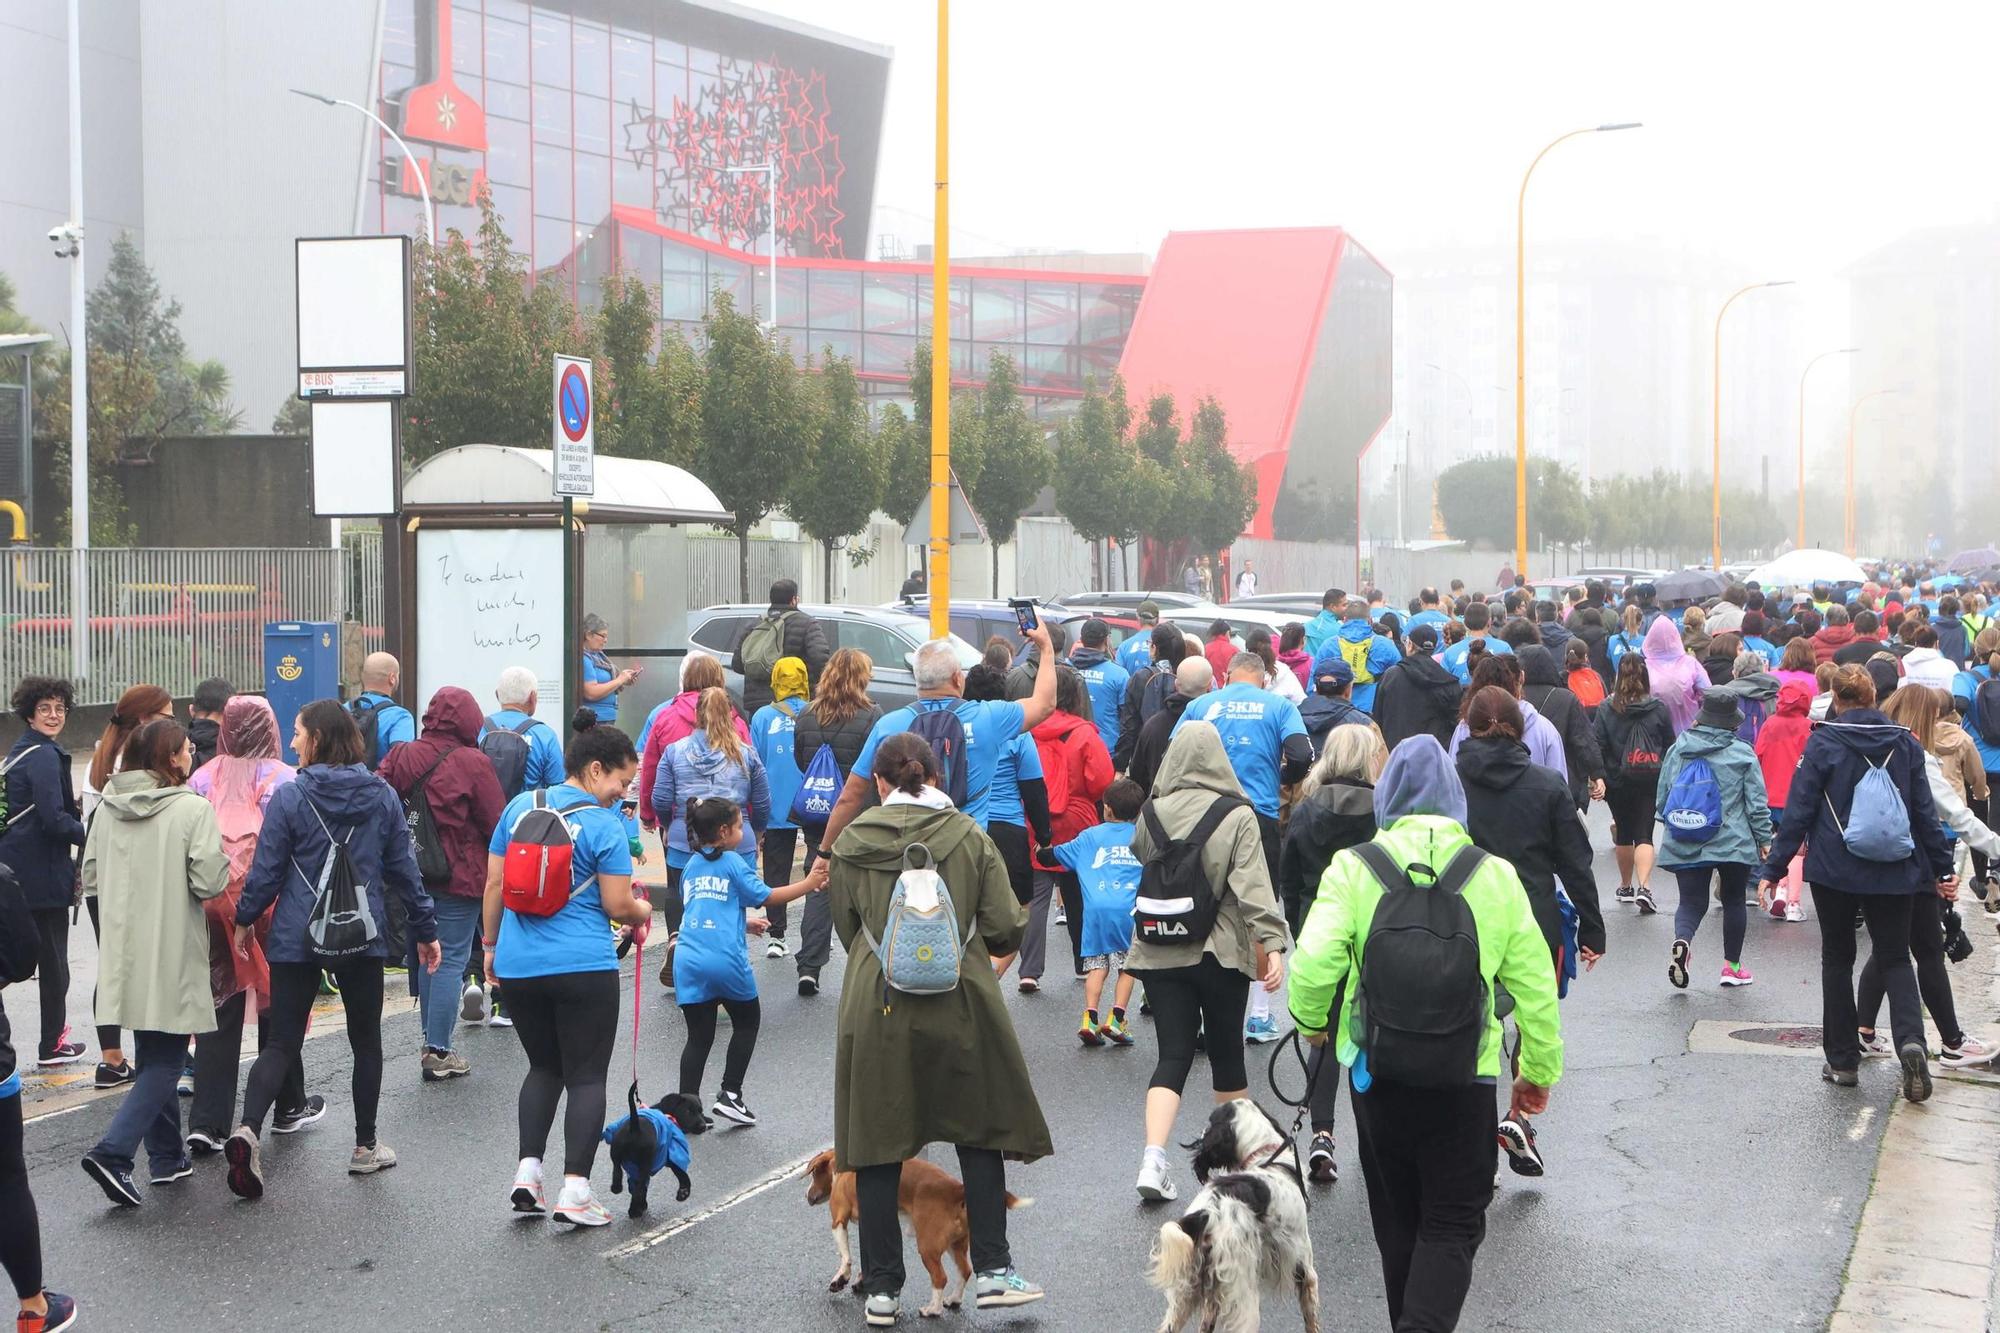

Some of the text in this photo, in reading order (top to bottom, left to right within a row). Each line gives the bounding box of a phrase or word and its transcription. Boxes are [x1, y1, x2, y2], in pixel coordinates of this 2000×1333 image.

[315, 373, 334, 386] BUS
[1227, 701, 1265, 714] 5KM
[815, 777, 835, 787] 5KM
[1111, 845, 1138, 859] 5K
[694, 875, 730, 894] 5KM
[1142, 920, 1189, 936] FILA
